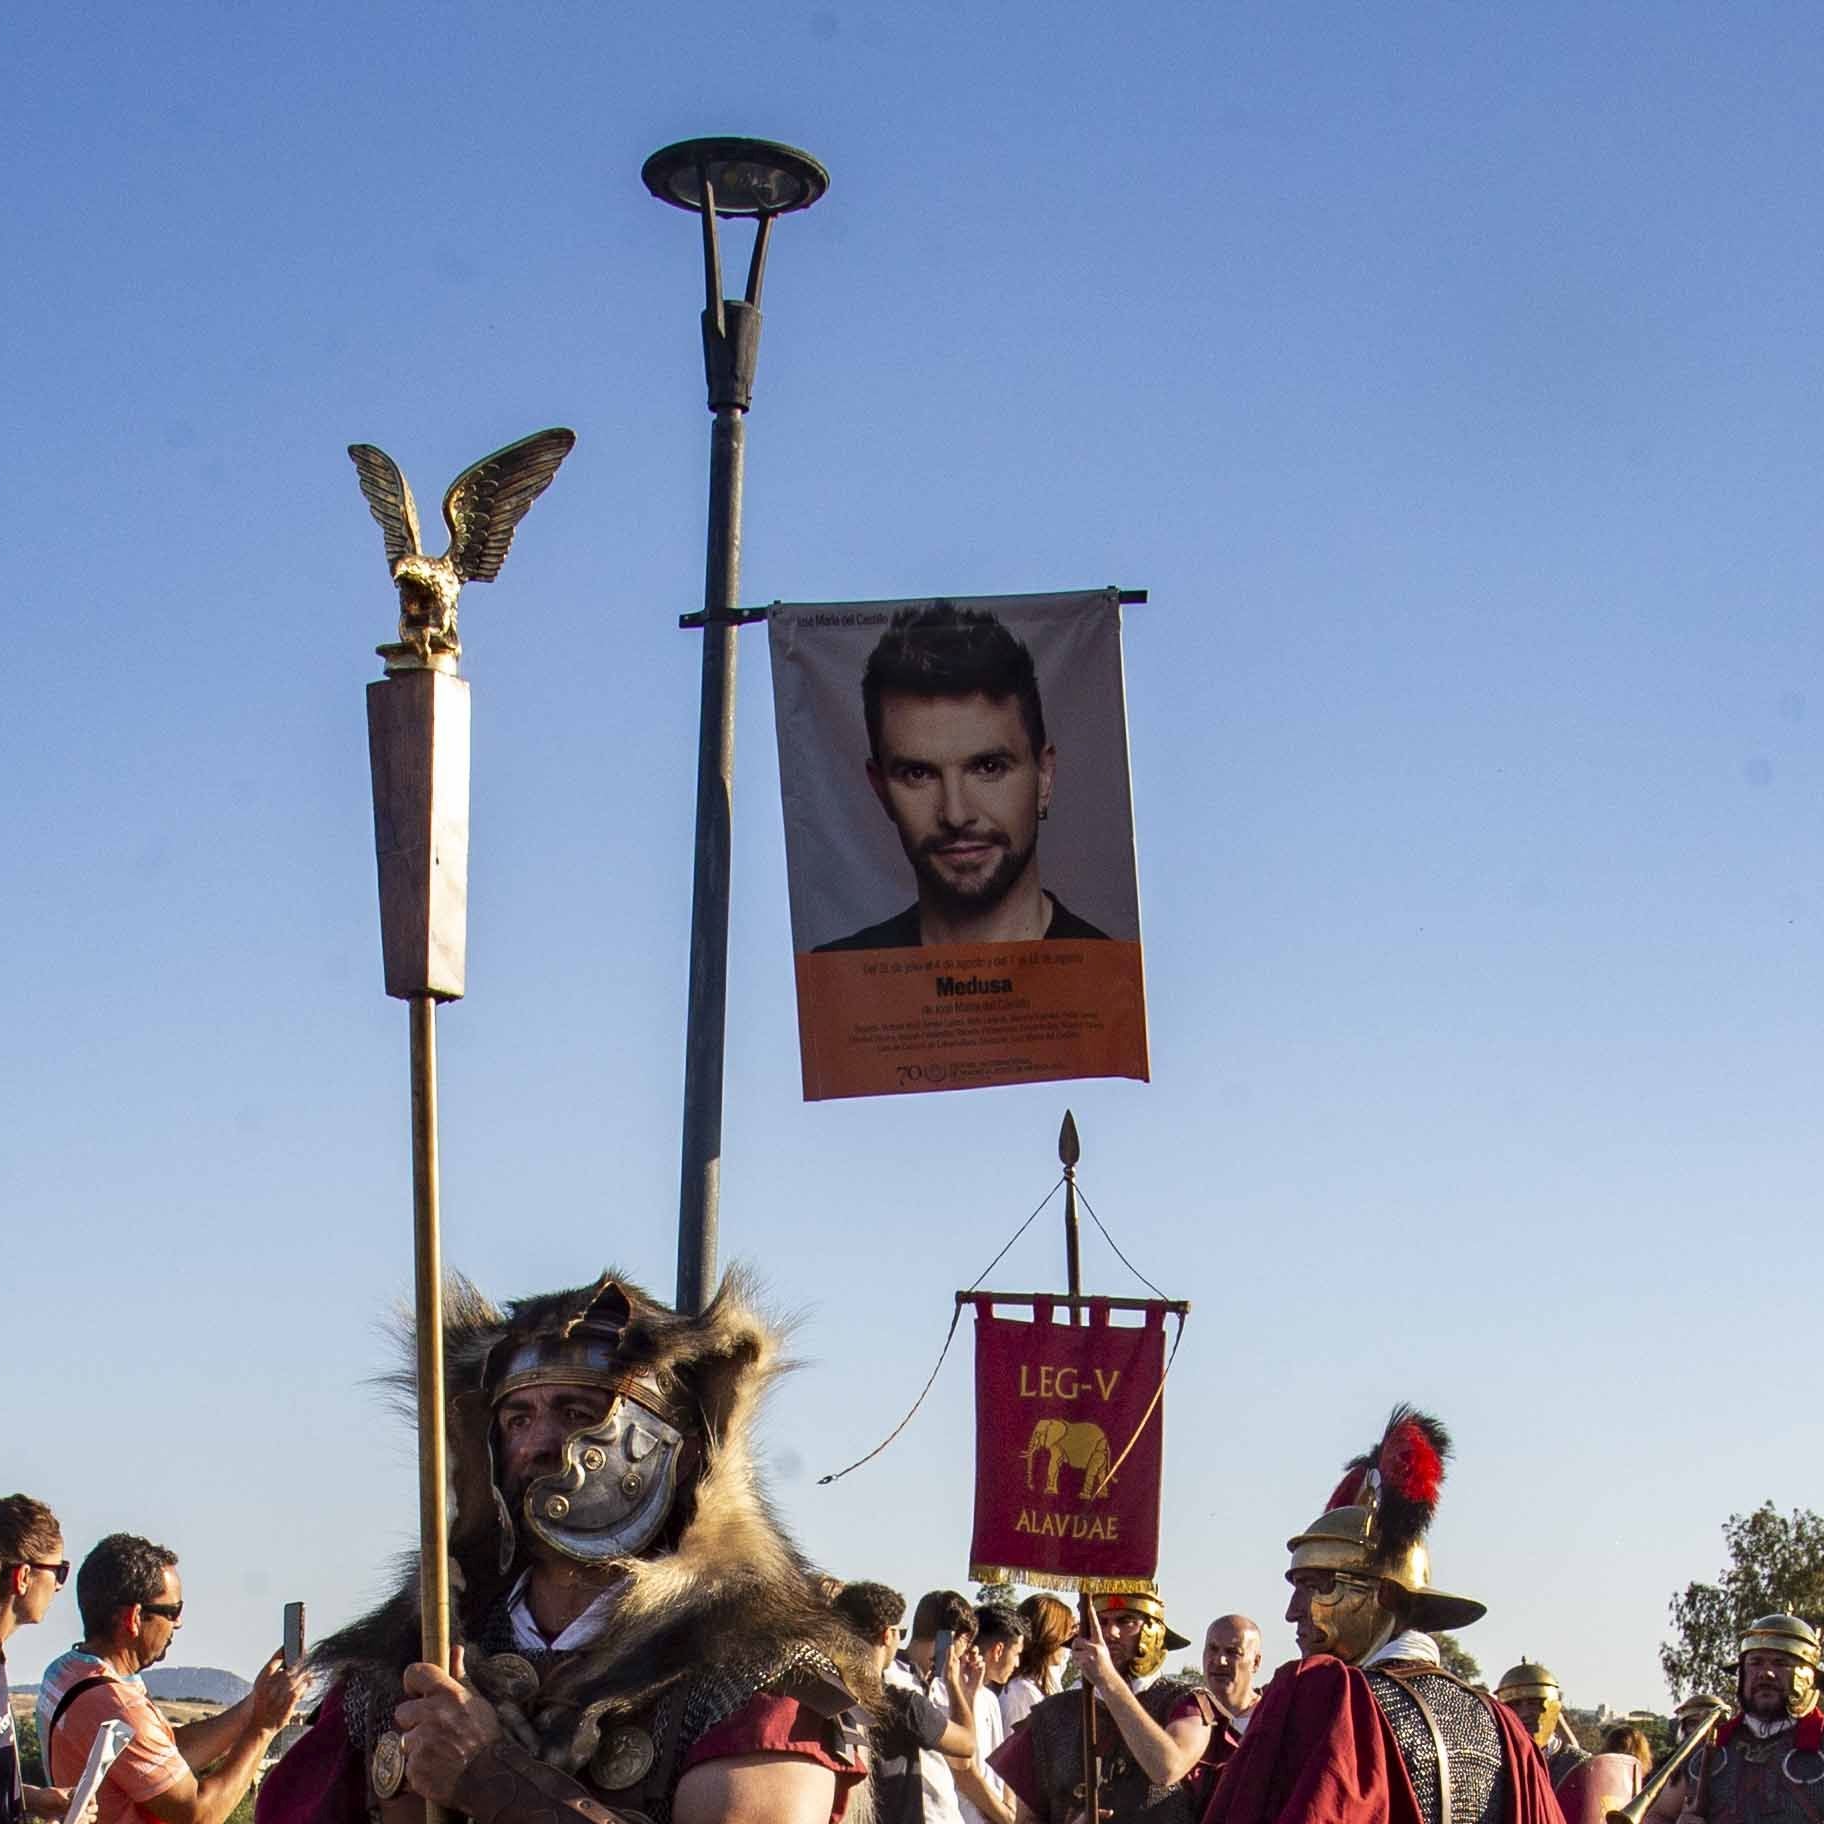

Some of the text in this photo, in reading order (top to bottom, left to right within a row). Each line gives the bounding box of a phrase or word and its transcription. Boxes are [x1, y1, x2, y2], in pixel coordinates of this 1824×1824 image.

[935, 976, 1014, 997] Medusa
[1020, 1364, 1121, 1401] LEG-V
[1014, 1509, 1120, 1540] ALAVDAE
